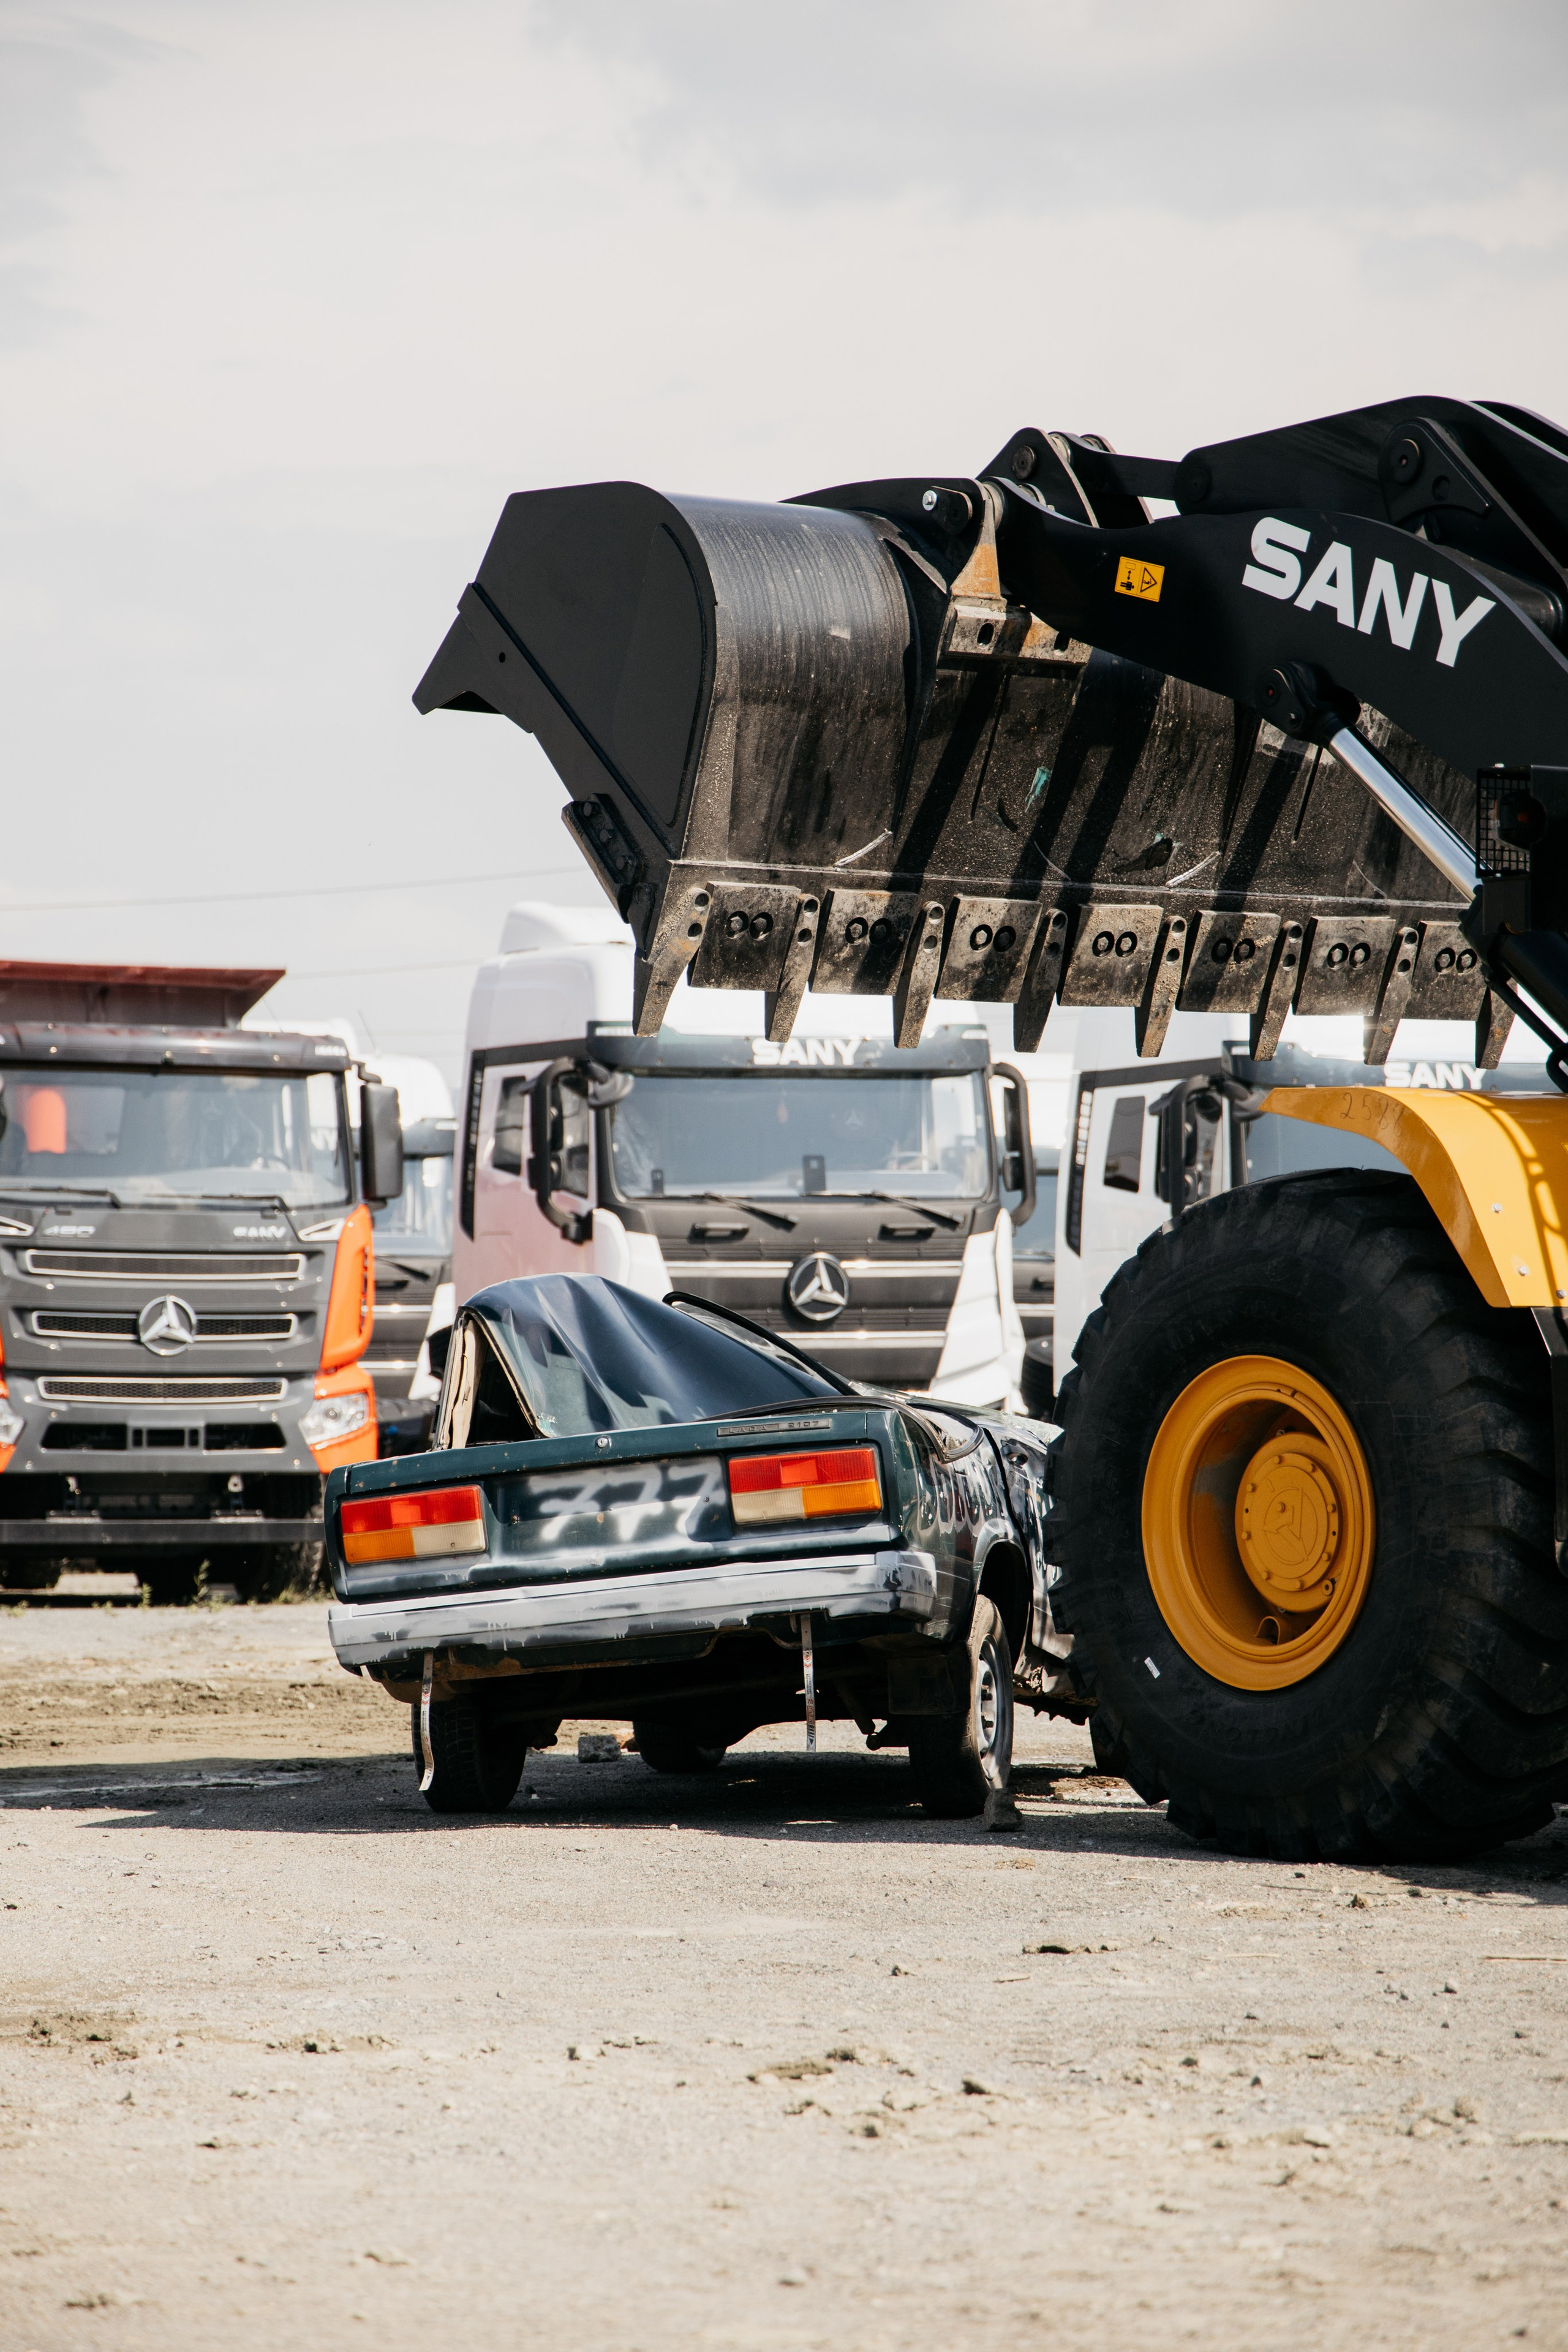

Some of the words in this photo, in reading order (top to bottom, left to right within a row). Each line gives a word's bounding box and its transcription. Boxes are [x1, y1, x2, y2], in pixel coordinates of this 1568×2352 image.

[1242, 517, 1496, 668] SANY
[752, 1036, 862, 1065] SANY
[1384, 1061, 1487, 1090] SANY
[728, 1425, 767, 1434] LADA
[527, 1458, 726, 1542] 777
